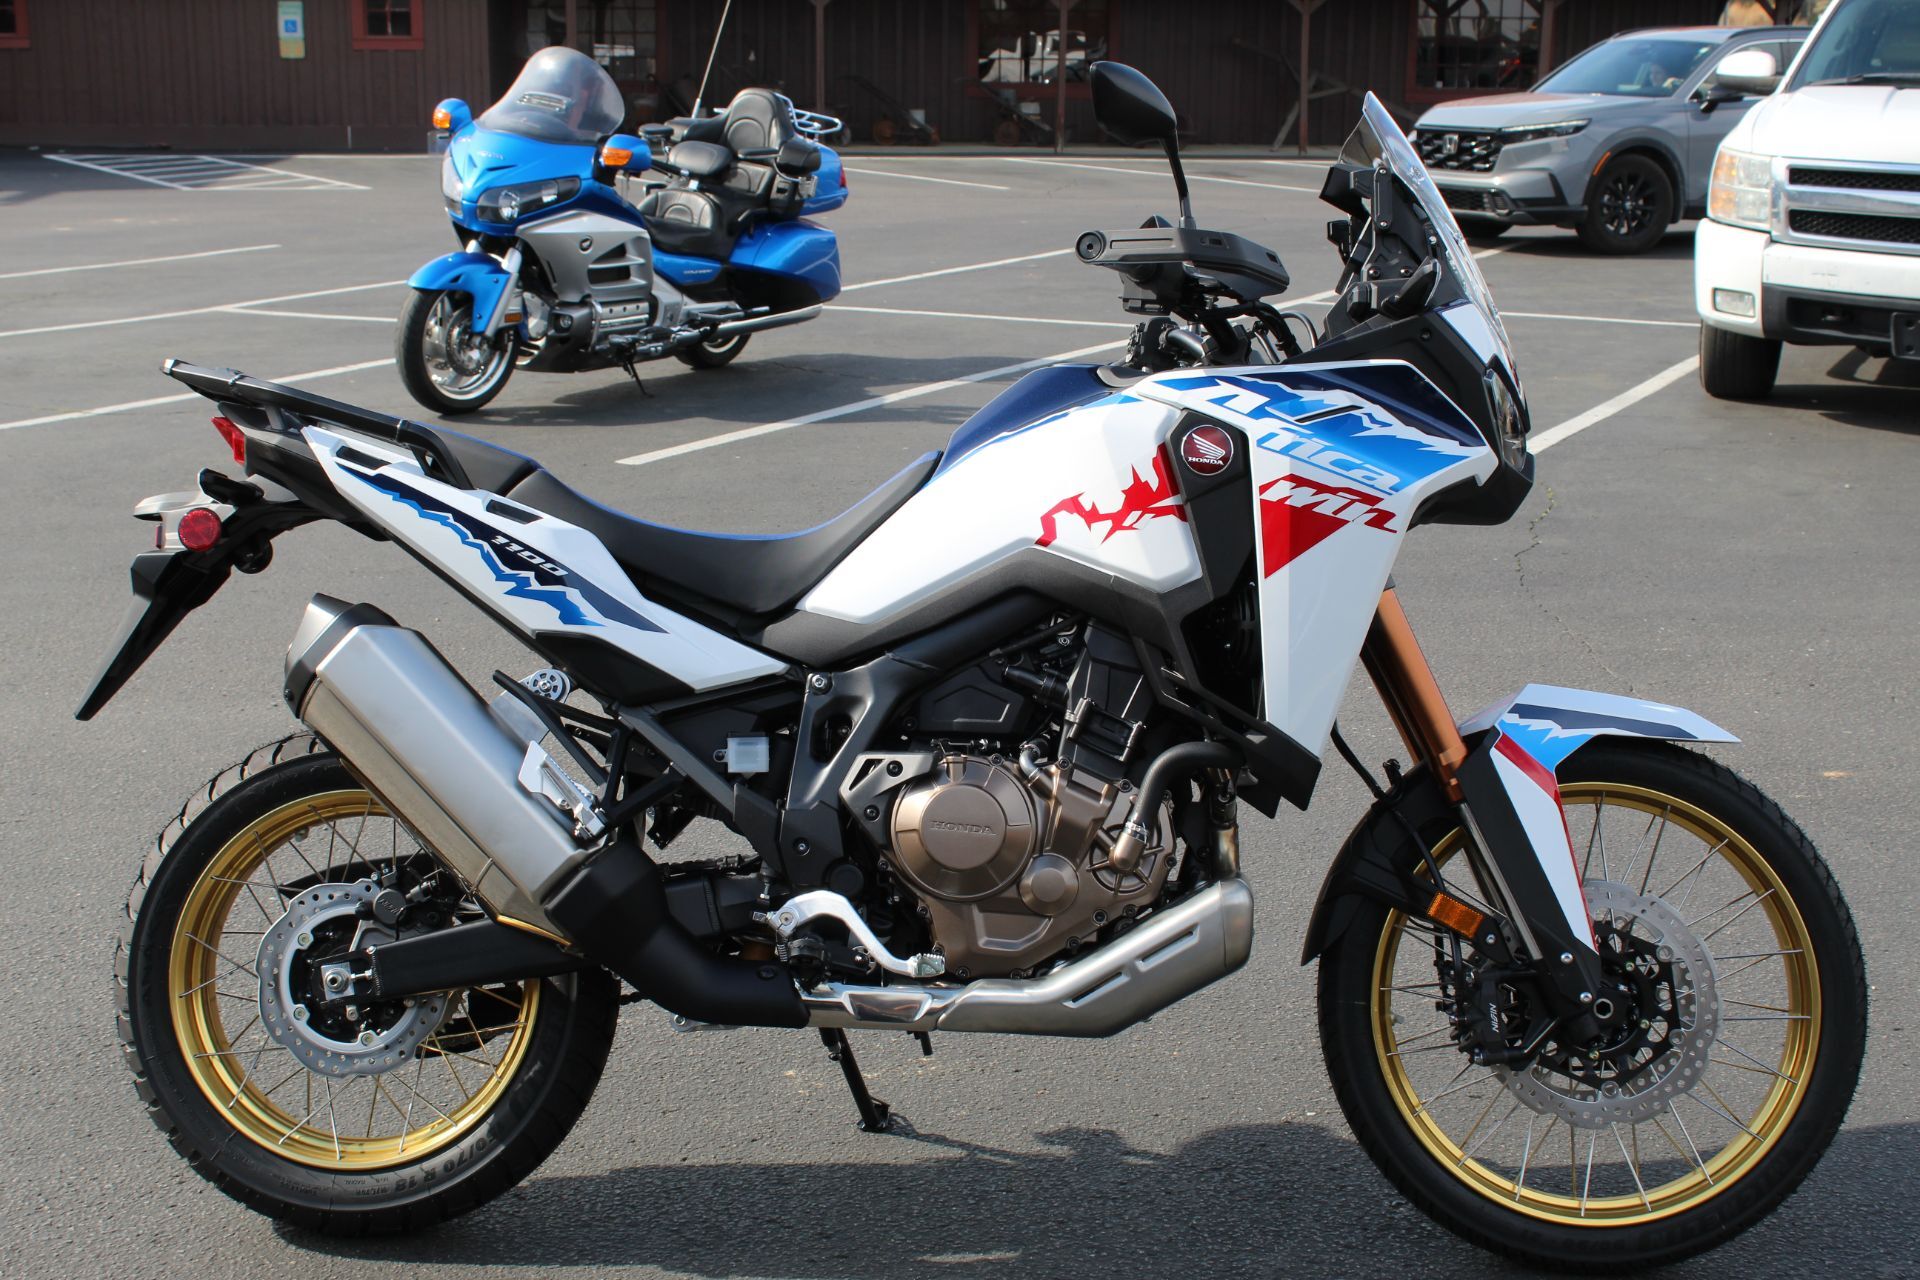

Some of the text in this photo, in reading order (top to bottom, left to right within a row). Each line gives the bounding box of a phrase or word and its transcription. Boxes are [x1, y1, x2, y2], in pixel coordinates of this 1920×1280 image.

[1188, 456, 1225, 466] HONDA
[491, 535, 569, 577] 1100
[929, 820, 998, 836] HONDA
